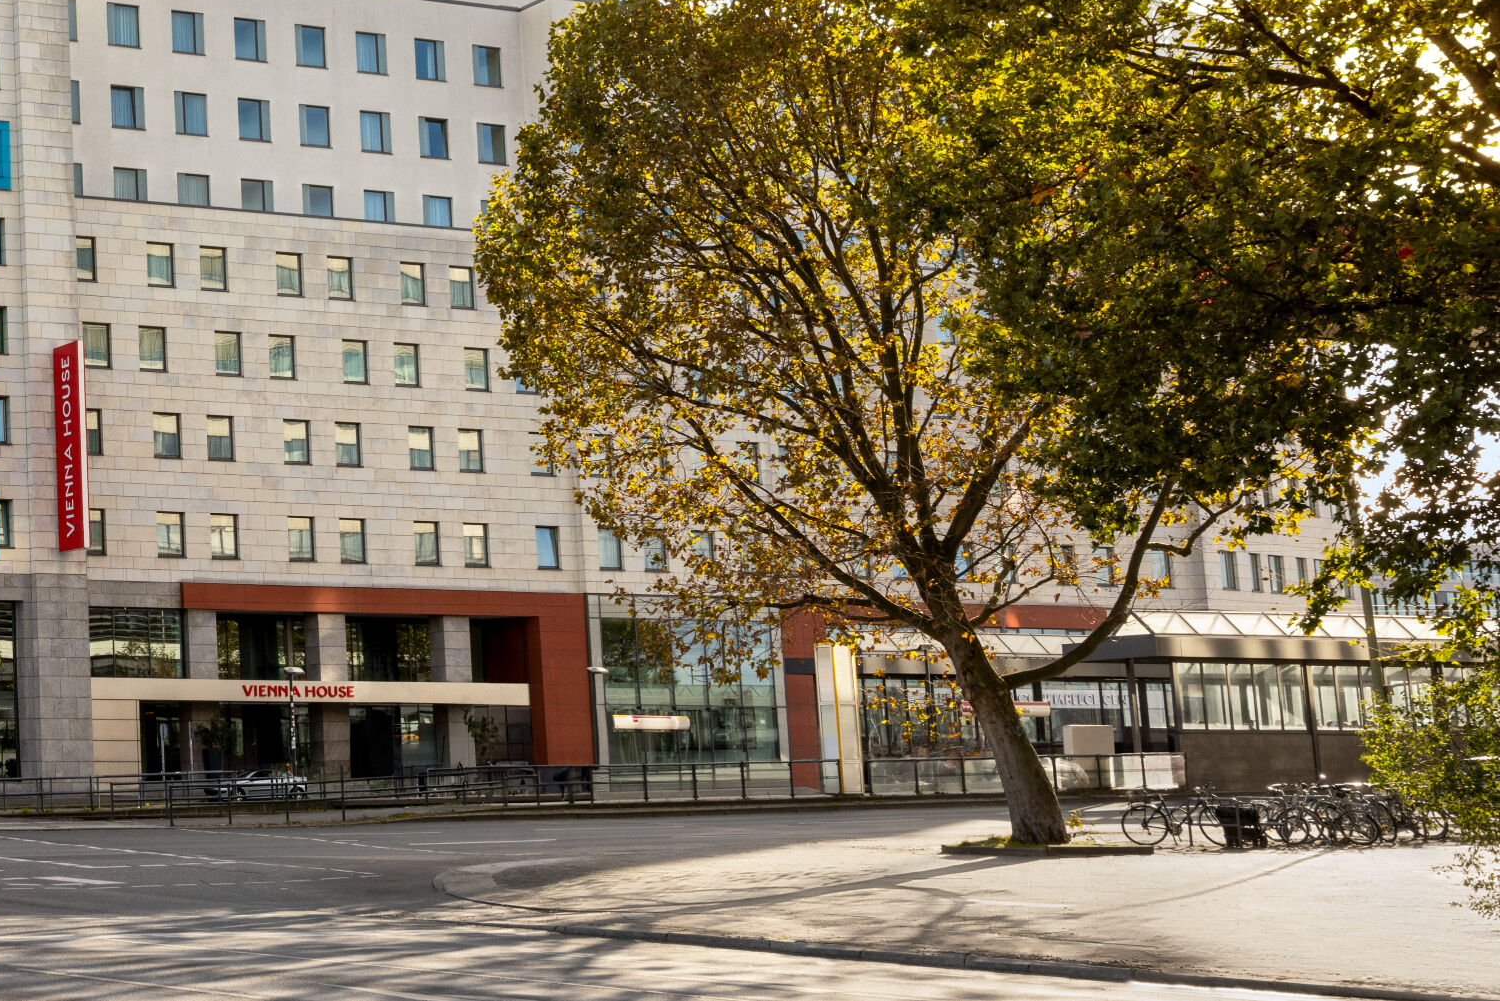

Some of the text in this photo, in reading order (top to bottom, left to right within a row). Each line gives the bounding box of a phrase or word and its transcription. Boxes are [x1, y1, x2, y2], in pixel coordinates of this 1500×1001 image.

[60, 355, 76, 538] VIENNA HOUSE
[242, 684, 356, 699] VIENNA HOUSE
